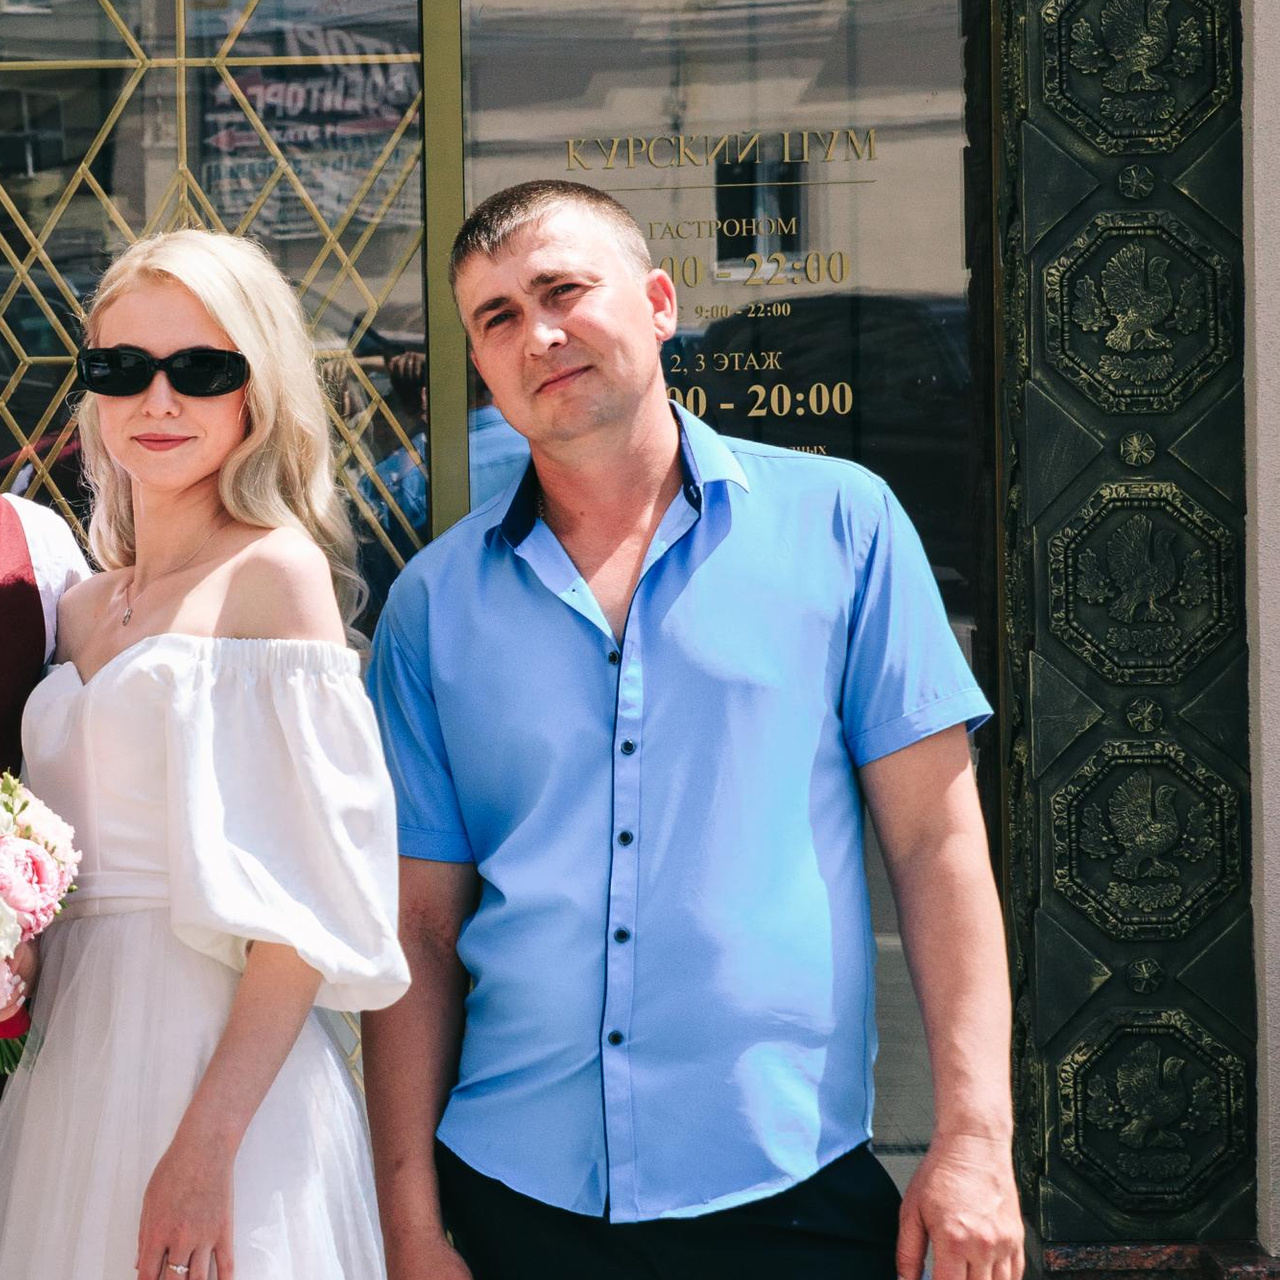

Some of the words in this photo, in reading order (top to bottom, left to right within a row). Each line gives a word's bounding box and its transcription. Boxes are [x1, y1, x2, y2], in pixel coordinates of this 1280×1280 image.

[565, 129, 761, 171] КУРСКИЙ
[781, 128, 877, 164] ЦУМ
[648, 217, 797, 239] ГАСТРОНОМ
[744, 251, 850, 286] 22:00
[695, 305, 730, 319] 9:00
[747, 302, 791, 318] 22:00
[695, 353, 706, 371] 3
[713, 351, 783, 371] ЭТАЖ
[747, 382, 853, 416] 20:00
